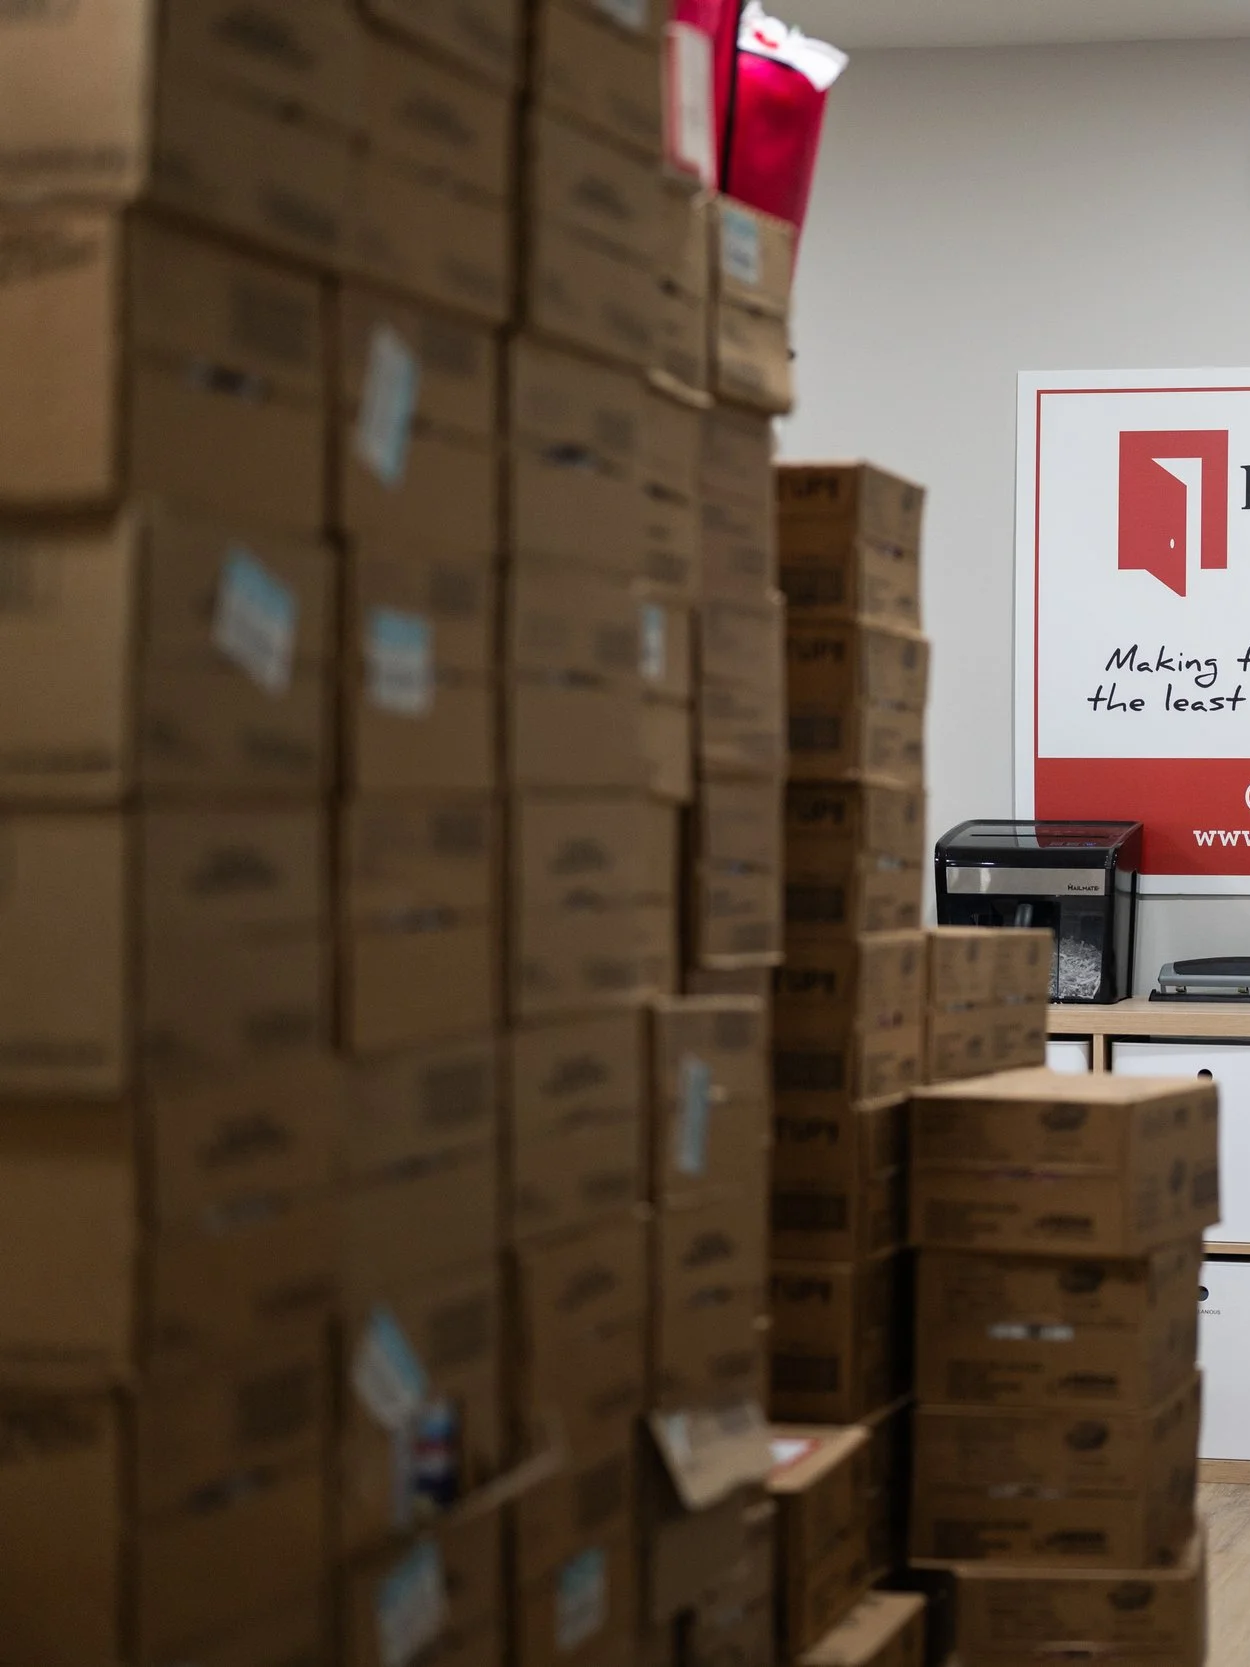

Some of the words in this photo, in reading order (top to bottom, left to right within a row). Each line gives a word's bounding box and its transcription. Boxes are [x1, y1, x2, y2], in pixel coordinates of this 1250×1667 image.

[1104, 643, 1218, 689] Making
[1086, 682, 1146, 713] the
[1165, 682, 1247, 712] least
